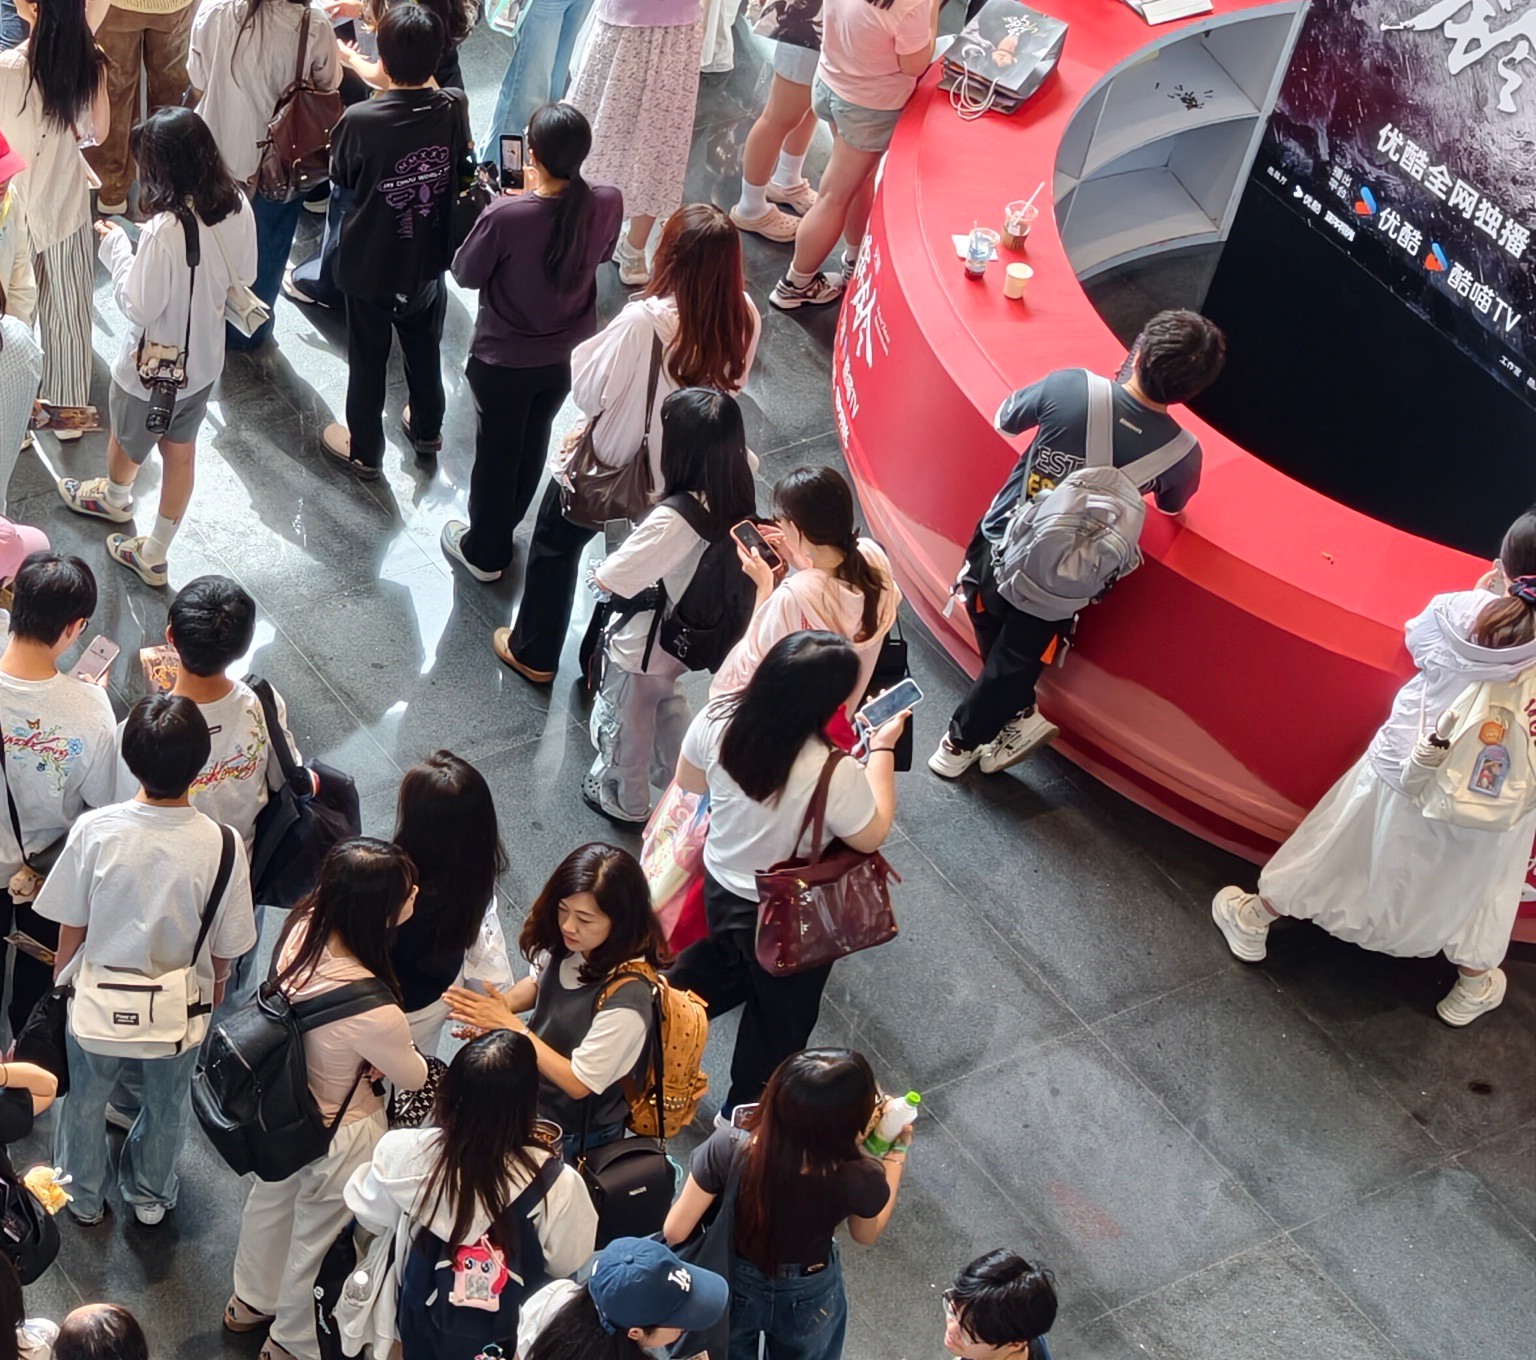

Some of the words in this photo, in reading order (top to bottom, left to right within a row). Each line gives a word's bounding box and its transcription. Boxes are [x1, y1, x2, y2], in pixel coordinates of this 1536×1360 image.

[1376, 122, 1531, 259] 优酷全网独播
[1378, 207, 1423, 256] 优酷
[1446, 262, 1522, 332] 酷喵TV
